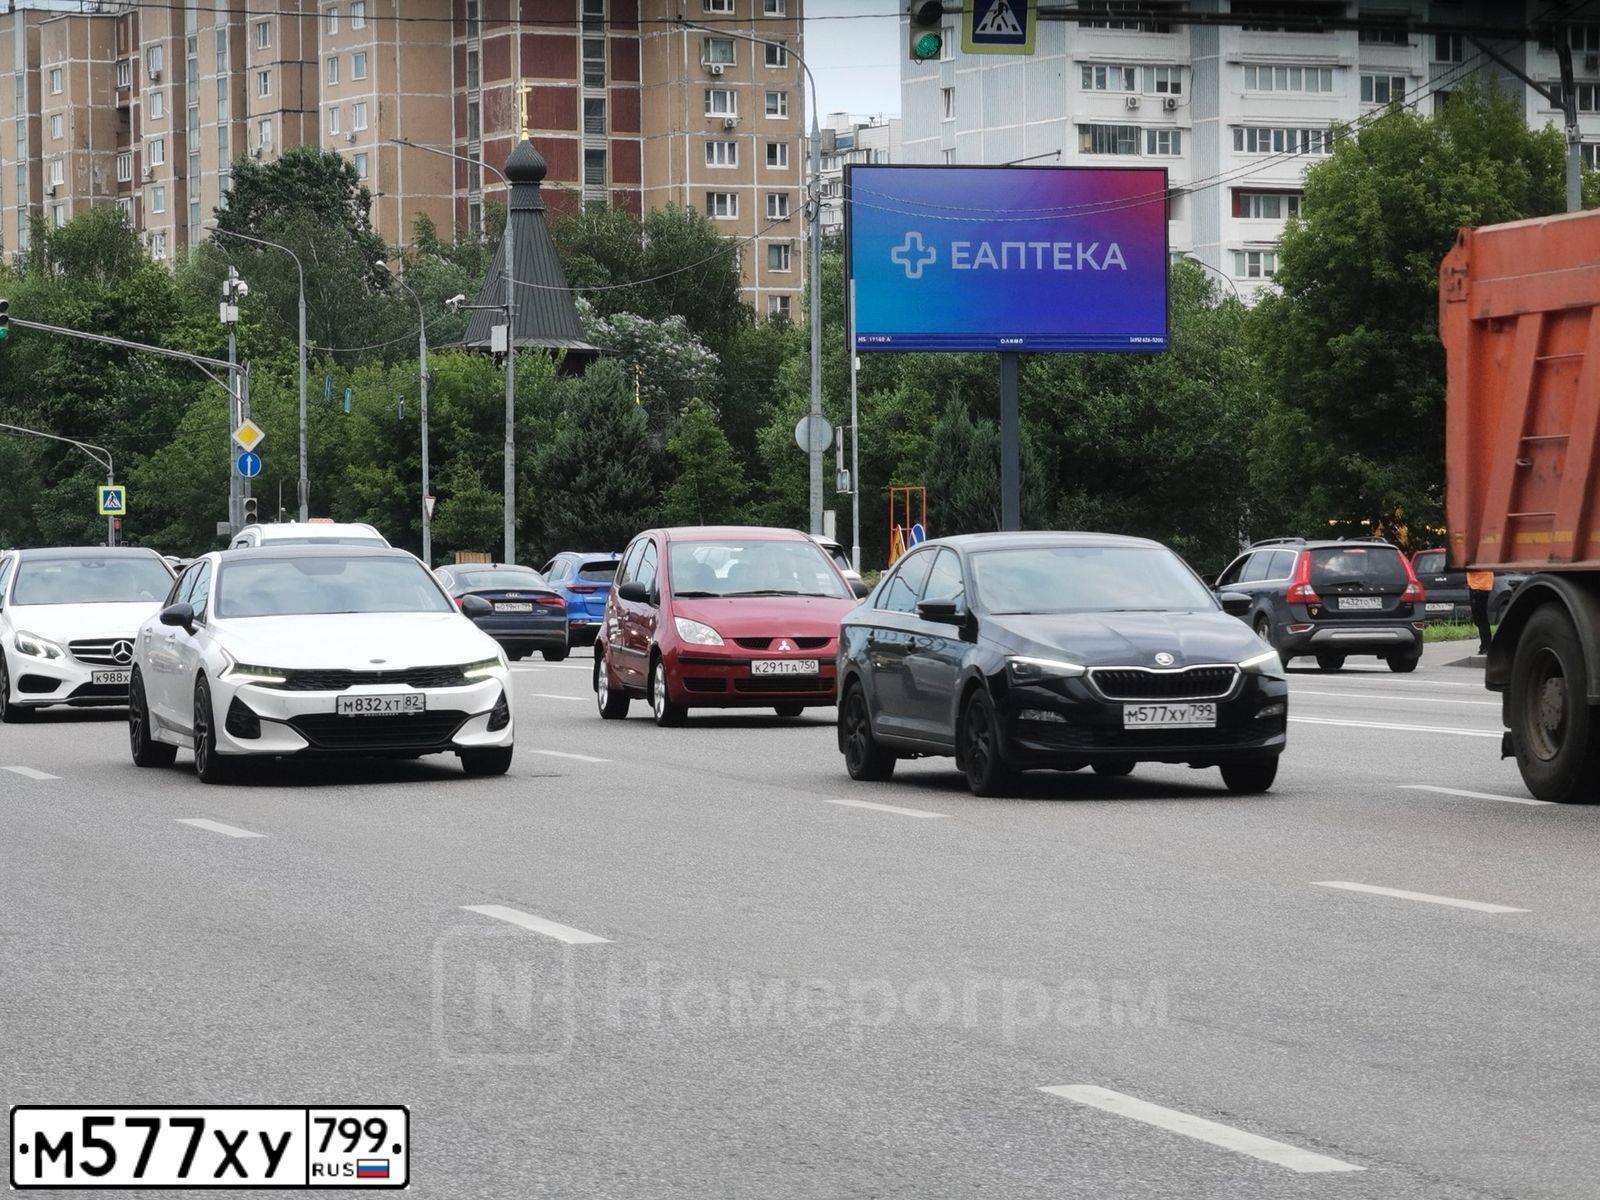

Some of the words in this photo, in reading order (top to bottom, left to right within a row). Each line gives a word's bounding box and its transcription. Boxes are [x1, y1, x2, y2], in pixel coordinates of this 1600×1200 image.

[951, 241, 1128, 271] ЕАПТЕКА
[755, 661, 798, 673] К291ТА
[800, 660, 816, 670] 750
[344, 697, 401, 712] М832ХТ
[405, 695, 419, 707] 82
[1127, 705, 1187, 722] М577ХУ
[1189, 704, 1212, 716] 799
